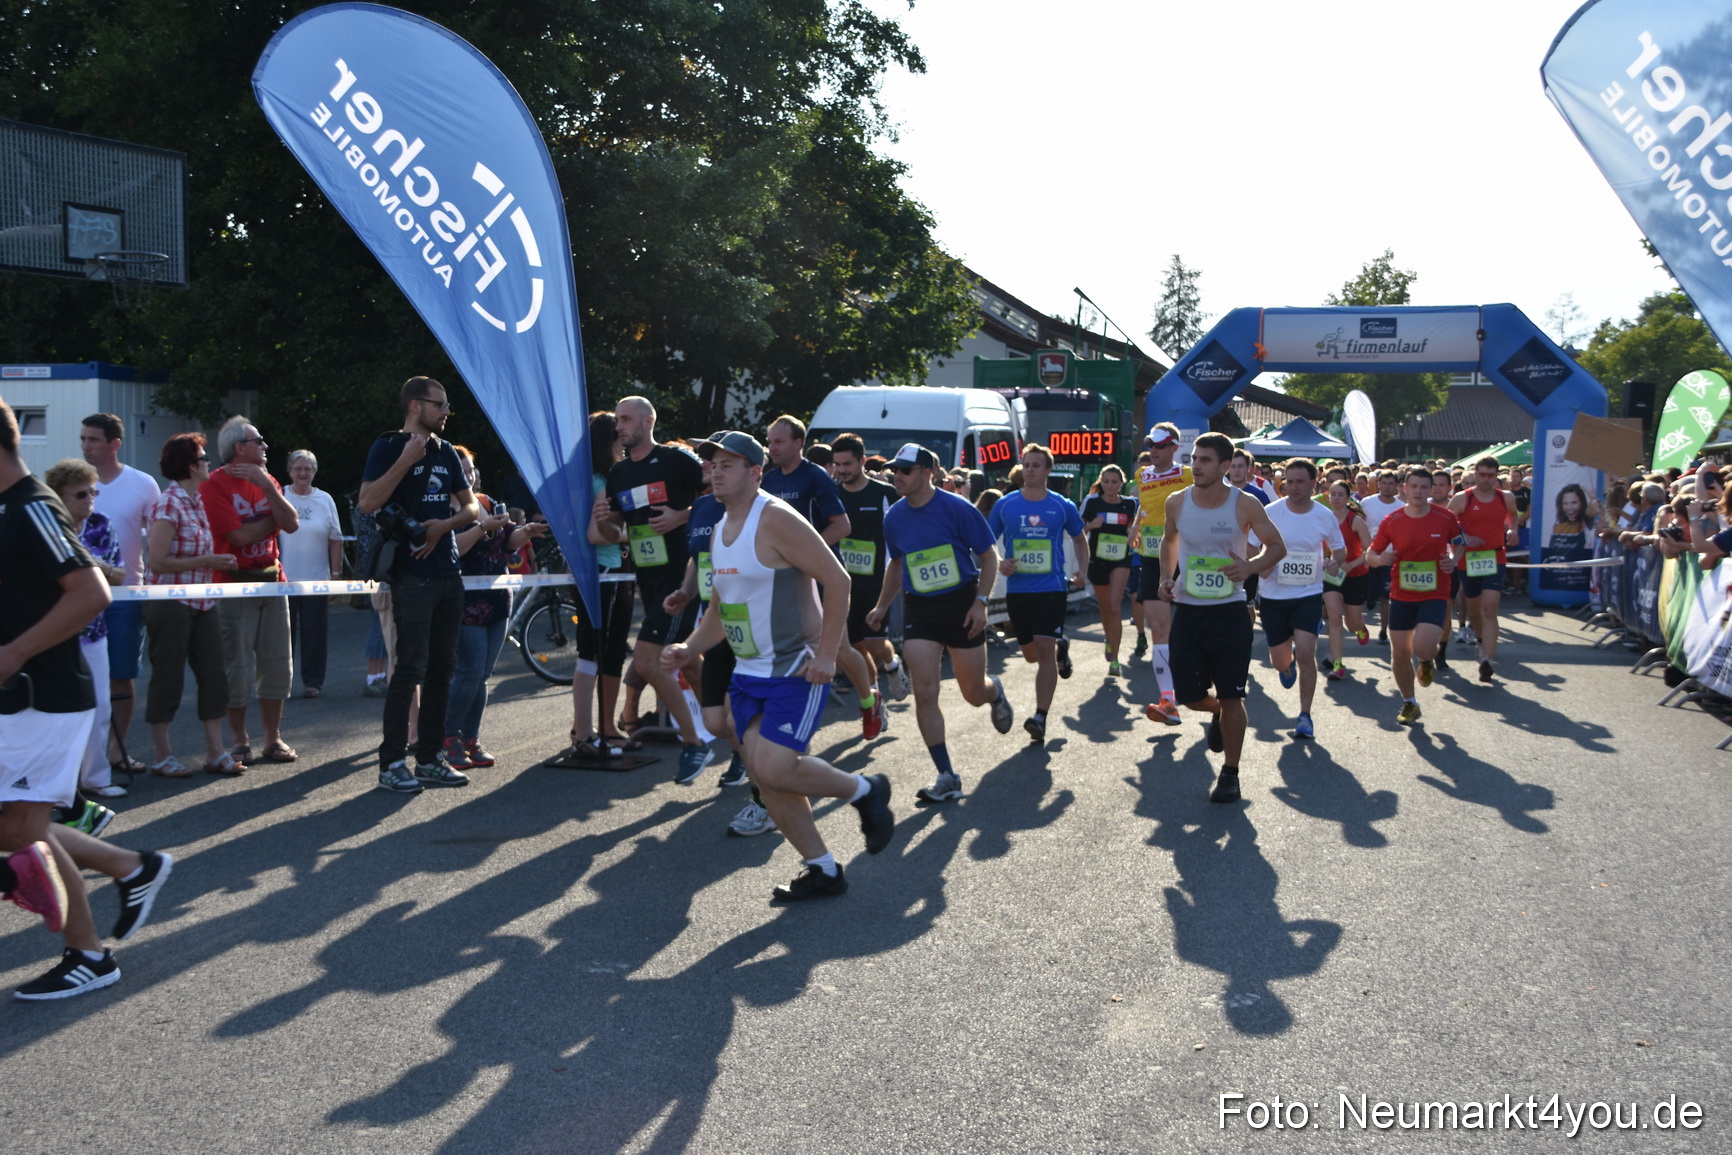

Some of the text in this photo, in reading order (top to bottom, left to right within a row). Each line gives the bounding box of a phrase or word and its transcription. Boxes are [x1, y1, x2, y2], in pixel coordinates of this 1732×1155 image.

[1346, 338, 1428, 354] firmenlauf
[1194, 366, 1238, 378] Fischer
[1050, 432, 1114, 455] 000033
[1658, 426, 1692, 458] AOK
[1020, 515, 1026, 527] I
[1020, 526, 1049, 535] camping
[640, 540, 655, 555] 43
[1105, 544, 1119, 554] 36
[842, 551, 872, 566] 1090
[1020, 552, 1045, 565] 485
[1470, 559, 1494, 570] 1372
[919, 562, 949, 582] 816
[1282, 562, 1313, 576] 8935
[1195, 572, 1225, 589] 350
[1403, 573, 1434, 584] 1046
